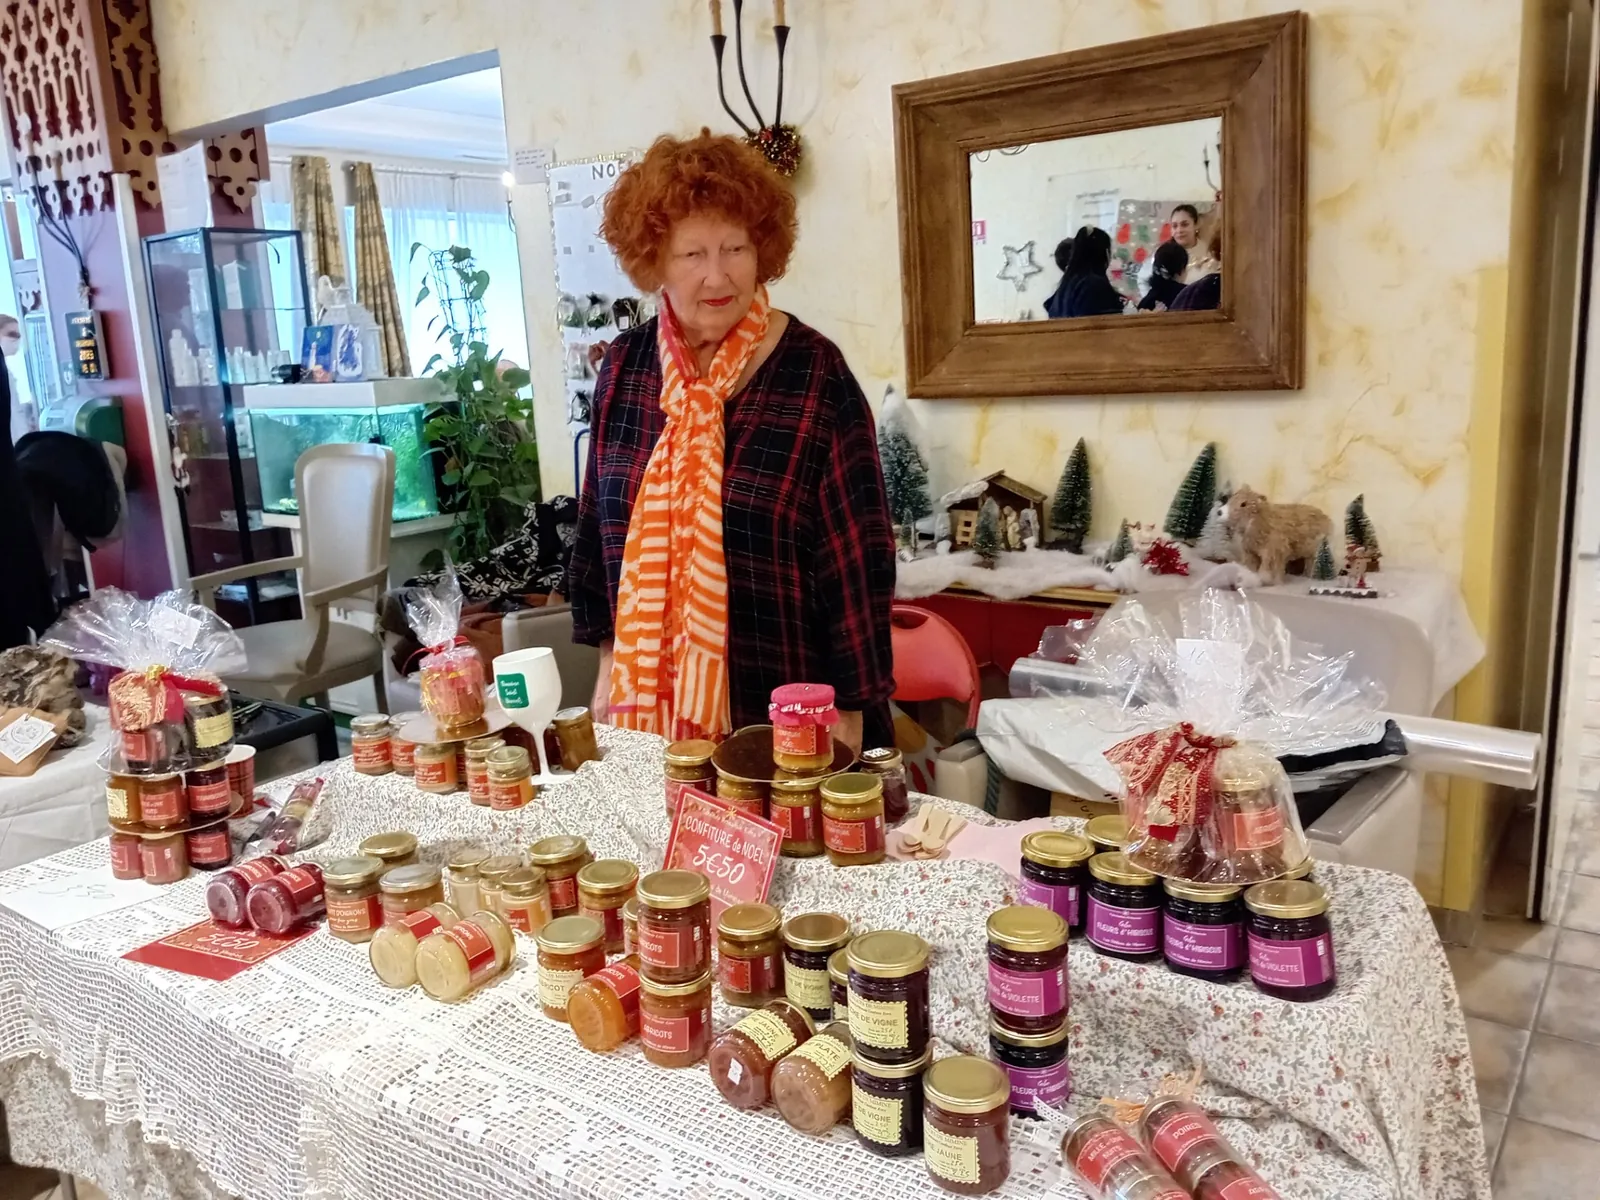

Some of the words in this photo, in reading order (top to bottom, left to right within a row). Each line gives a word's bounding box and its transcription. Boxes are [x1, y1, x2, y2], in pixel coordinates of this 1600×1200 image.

[685, 815, 733, 848] CONFITURE
[732, 838, 742, 853] de
[742, 842, 764, 865] NOEL
[692, 844, 746, 884] 5€50
[1266, 963, 1299, 973] VIOLETTE
[1007, 993, 1040, 1003] VIOLETTE
[861, 1015, 870, 1023] DE
[871, 1018, 898, 1027] VIGNE
[814, 1041, 841, 1062] PLATE
[1012, 1086, 1037, 1096] FLEURS
[867, 1111, 892, 1123] VIGNE
[937, 1148, 962, 1161] JAUNE
